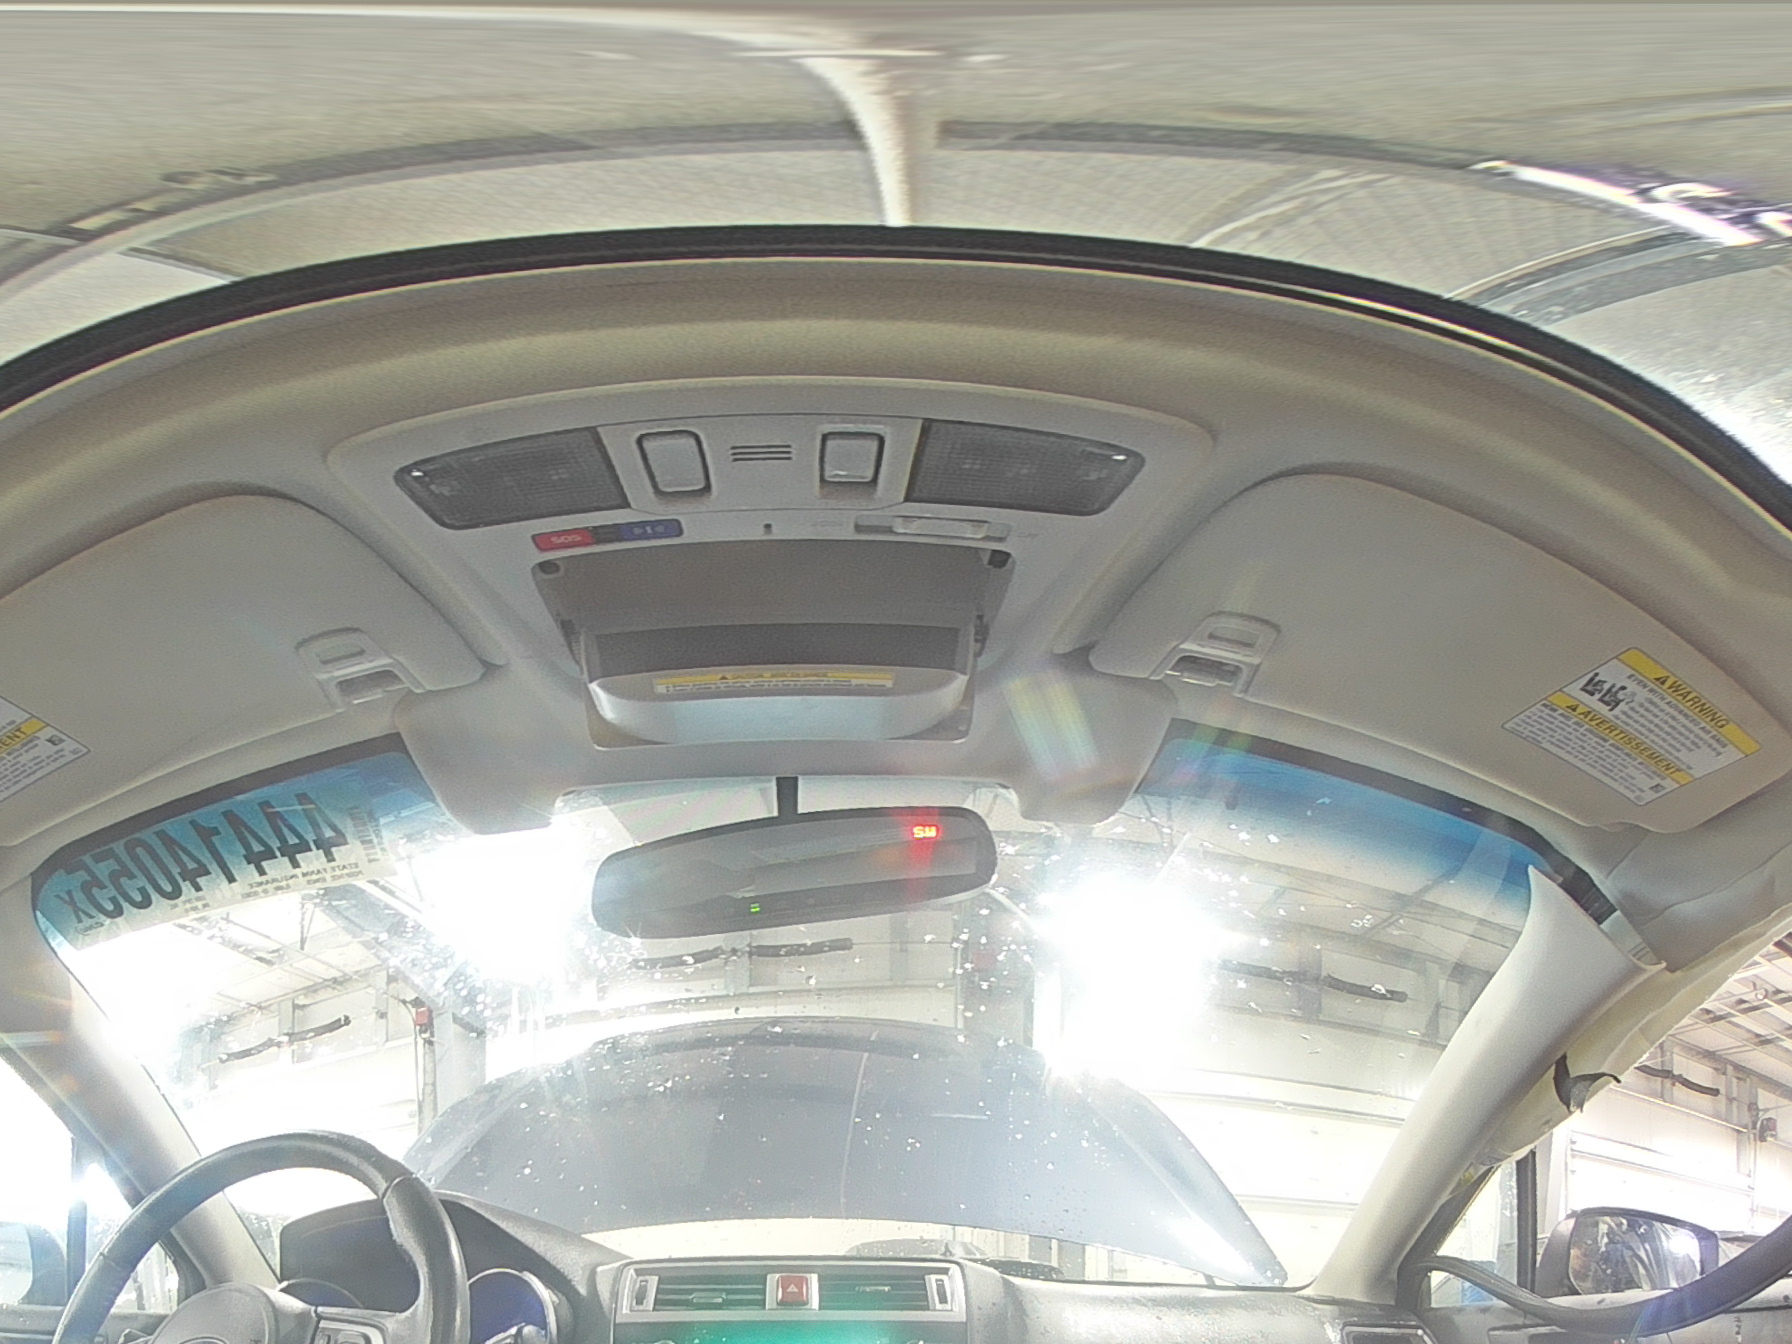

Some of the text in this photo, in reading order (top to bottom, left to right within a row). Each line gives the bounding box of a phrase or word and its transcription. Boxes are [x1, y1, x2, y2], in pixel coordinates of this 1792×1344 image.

[550, 534, 582, 544] SOS
[1666, 680, 1730, 729] WARNING
[1578, 710, 1681, 775] AVERTISSEMENT
